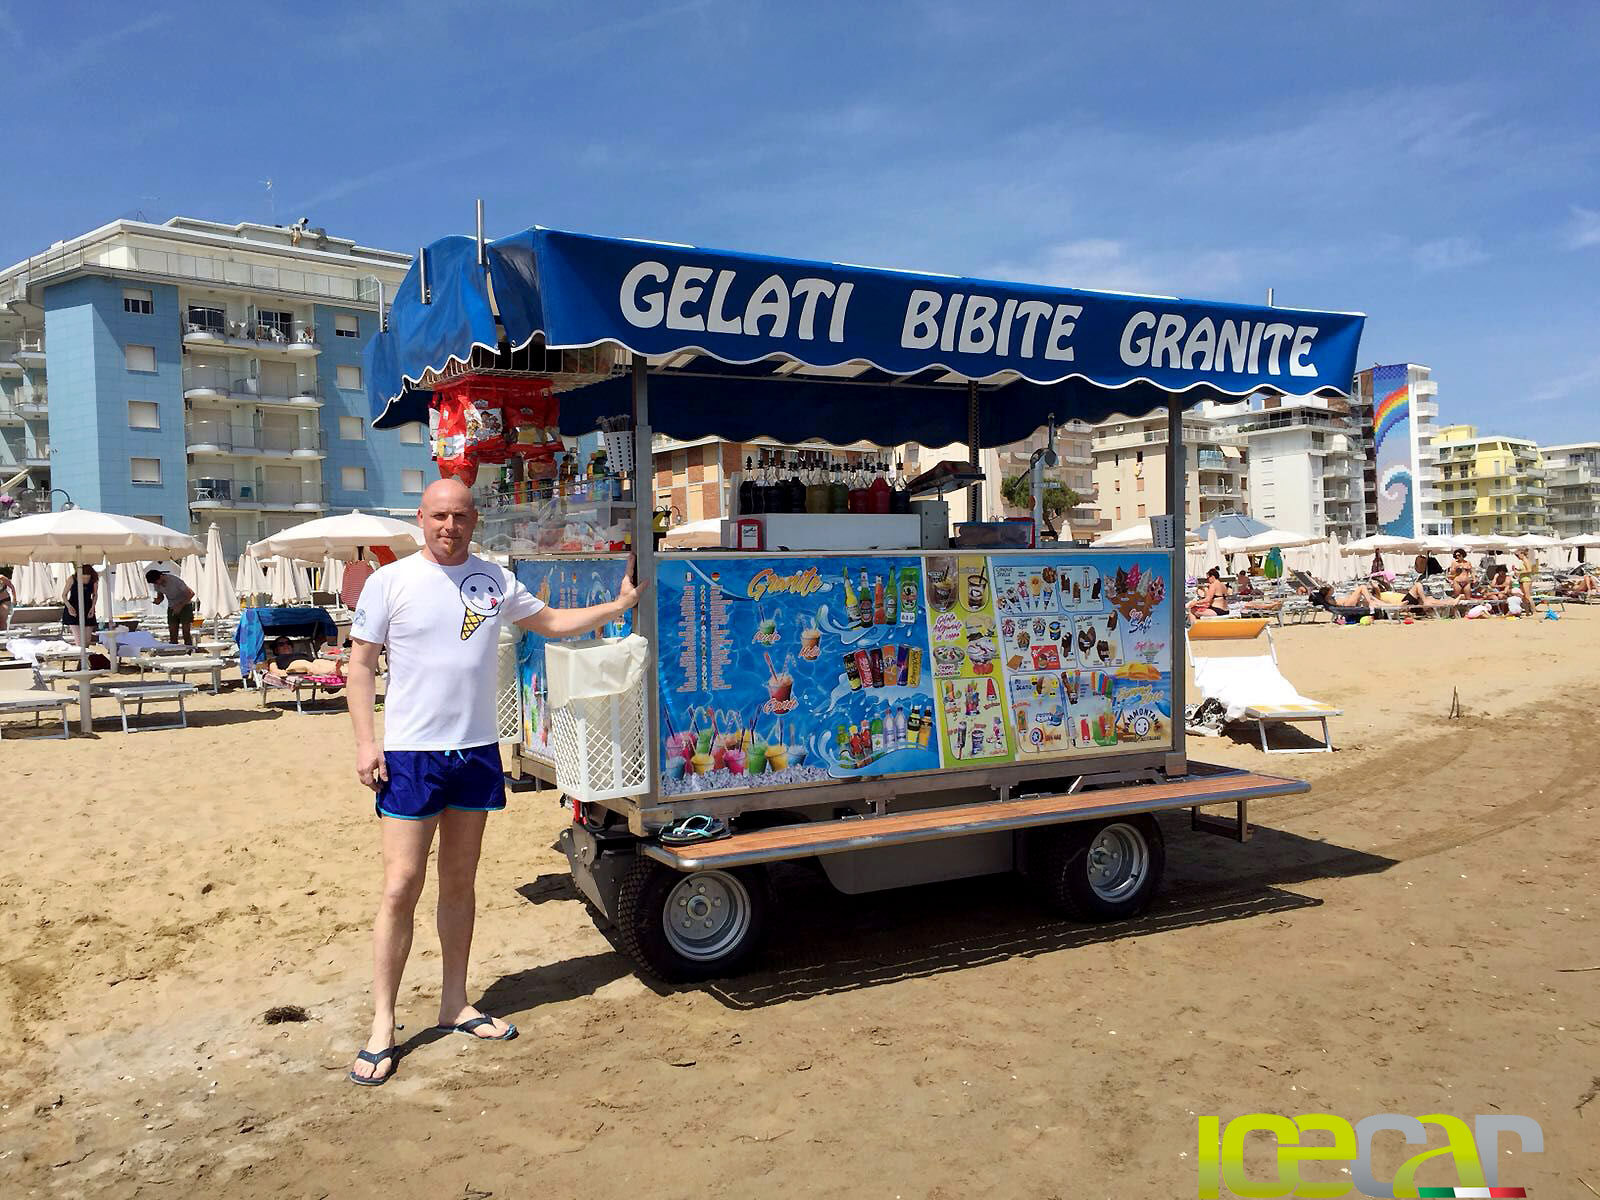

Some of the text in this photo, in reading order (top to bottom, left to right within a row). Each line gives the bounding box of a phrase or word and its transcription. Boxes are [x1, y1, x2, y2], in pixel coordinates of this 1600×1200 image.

[619, 261, 1319, 377] GELATI BIBITE GRANITE
[1129, 616, 1152, 634] Soft
